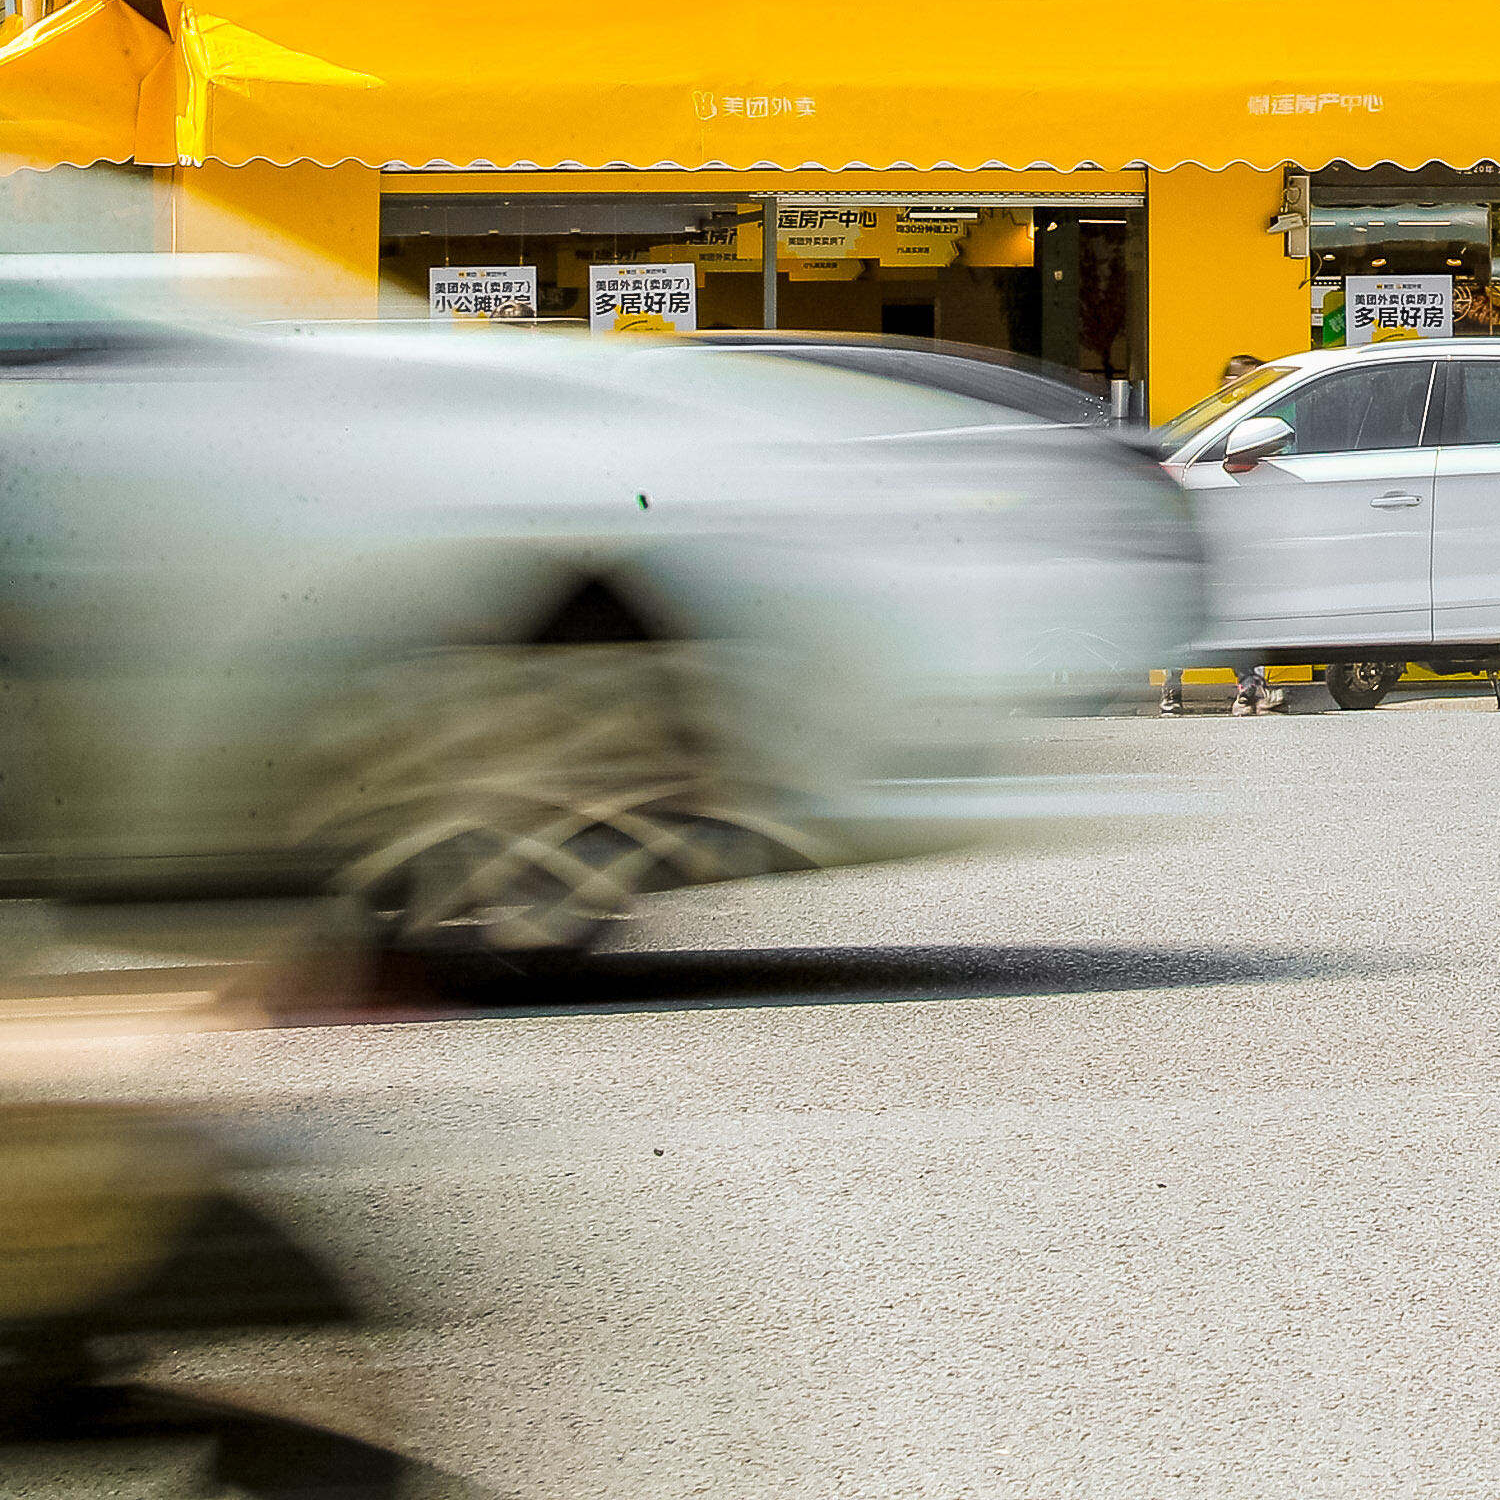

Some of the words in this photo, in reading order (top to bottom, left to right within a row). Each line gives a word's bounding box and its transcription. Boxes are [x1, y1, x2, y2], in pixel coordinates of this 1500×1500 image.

[721, 96, 817, 119] 美团外卖
[434, 280, 531, 294] 美团外卖(卖房了)
[595, 277, 690, 292] 美团外卖(卖房了)
[595, 291, 691, 316] 多居好房
[1354, 292, 1444, 306] 美团外卖(卖房了)
[1354, 305, 1445, 329] 多居好房
